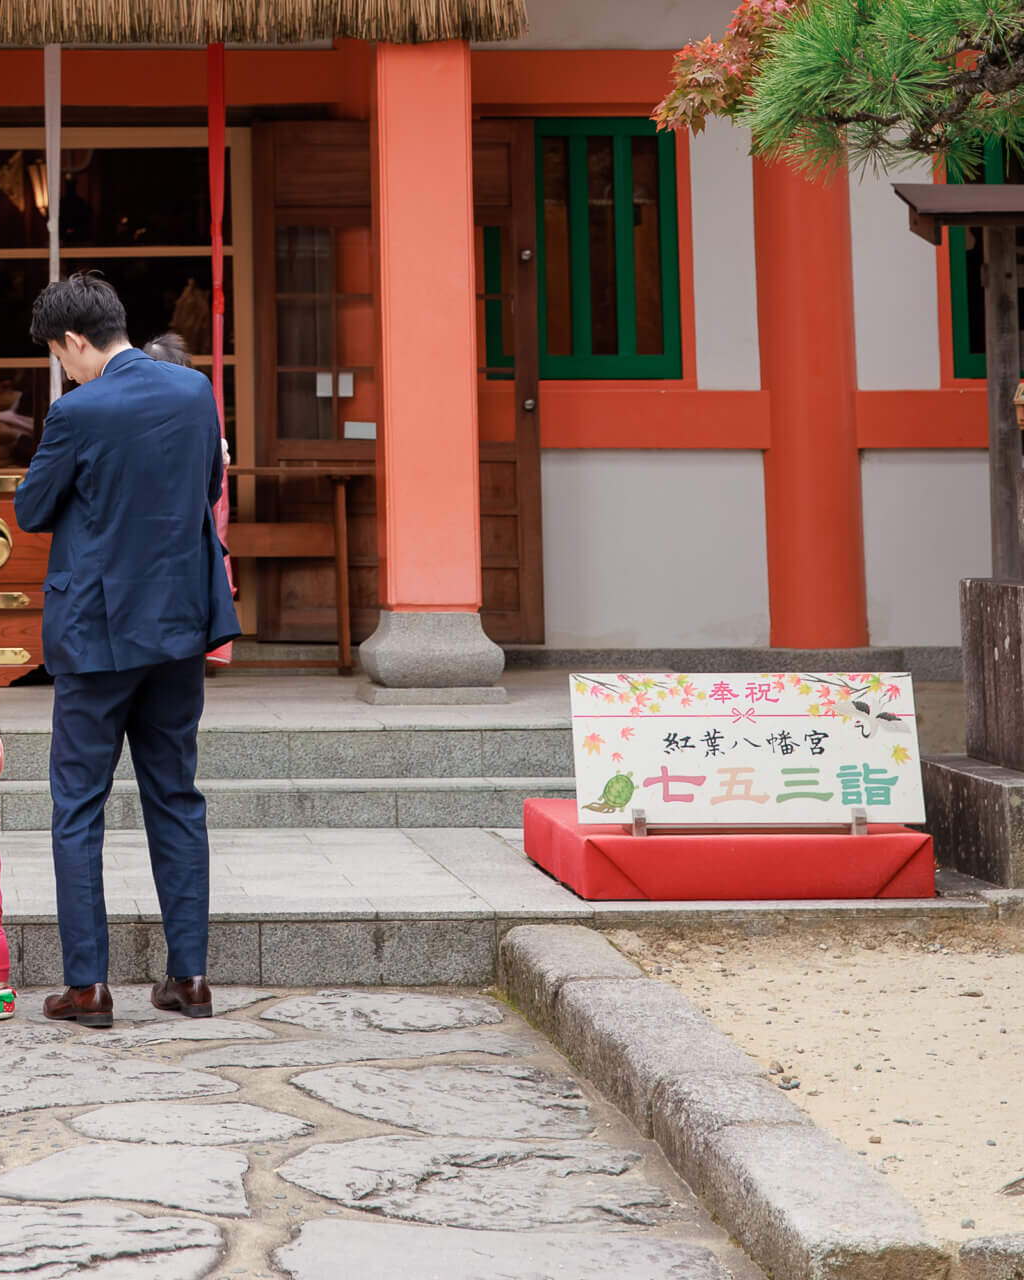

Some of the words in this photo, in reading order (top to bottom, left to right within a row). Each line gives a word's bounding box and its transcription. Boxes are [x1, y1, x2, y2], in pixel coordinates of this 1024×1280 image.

[709, 680, 779, 704] 奉祝
[663, 728, 830, 757] 紅葉八幡宮
[643, 763, 899, 806] 七五三詣
